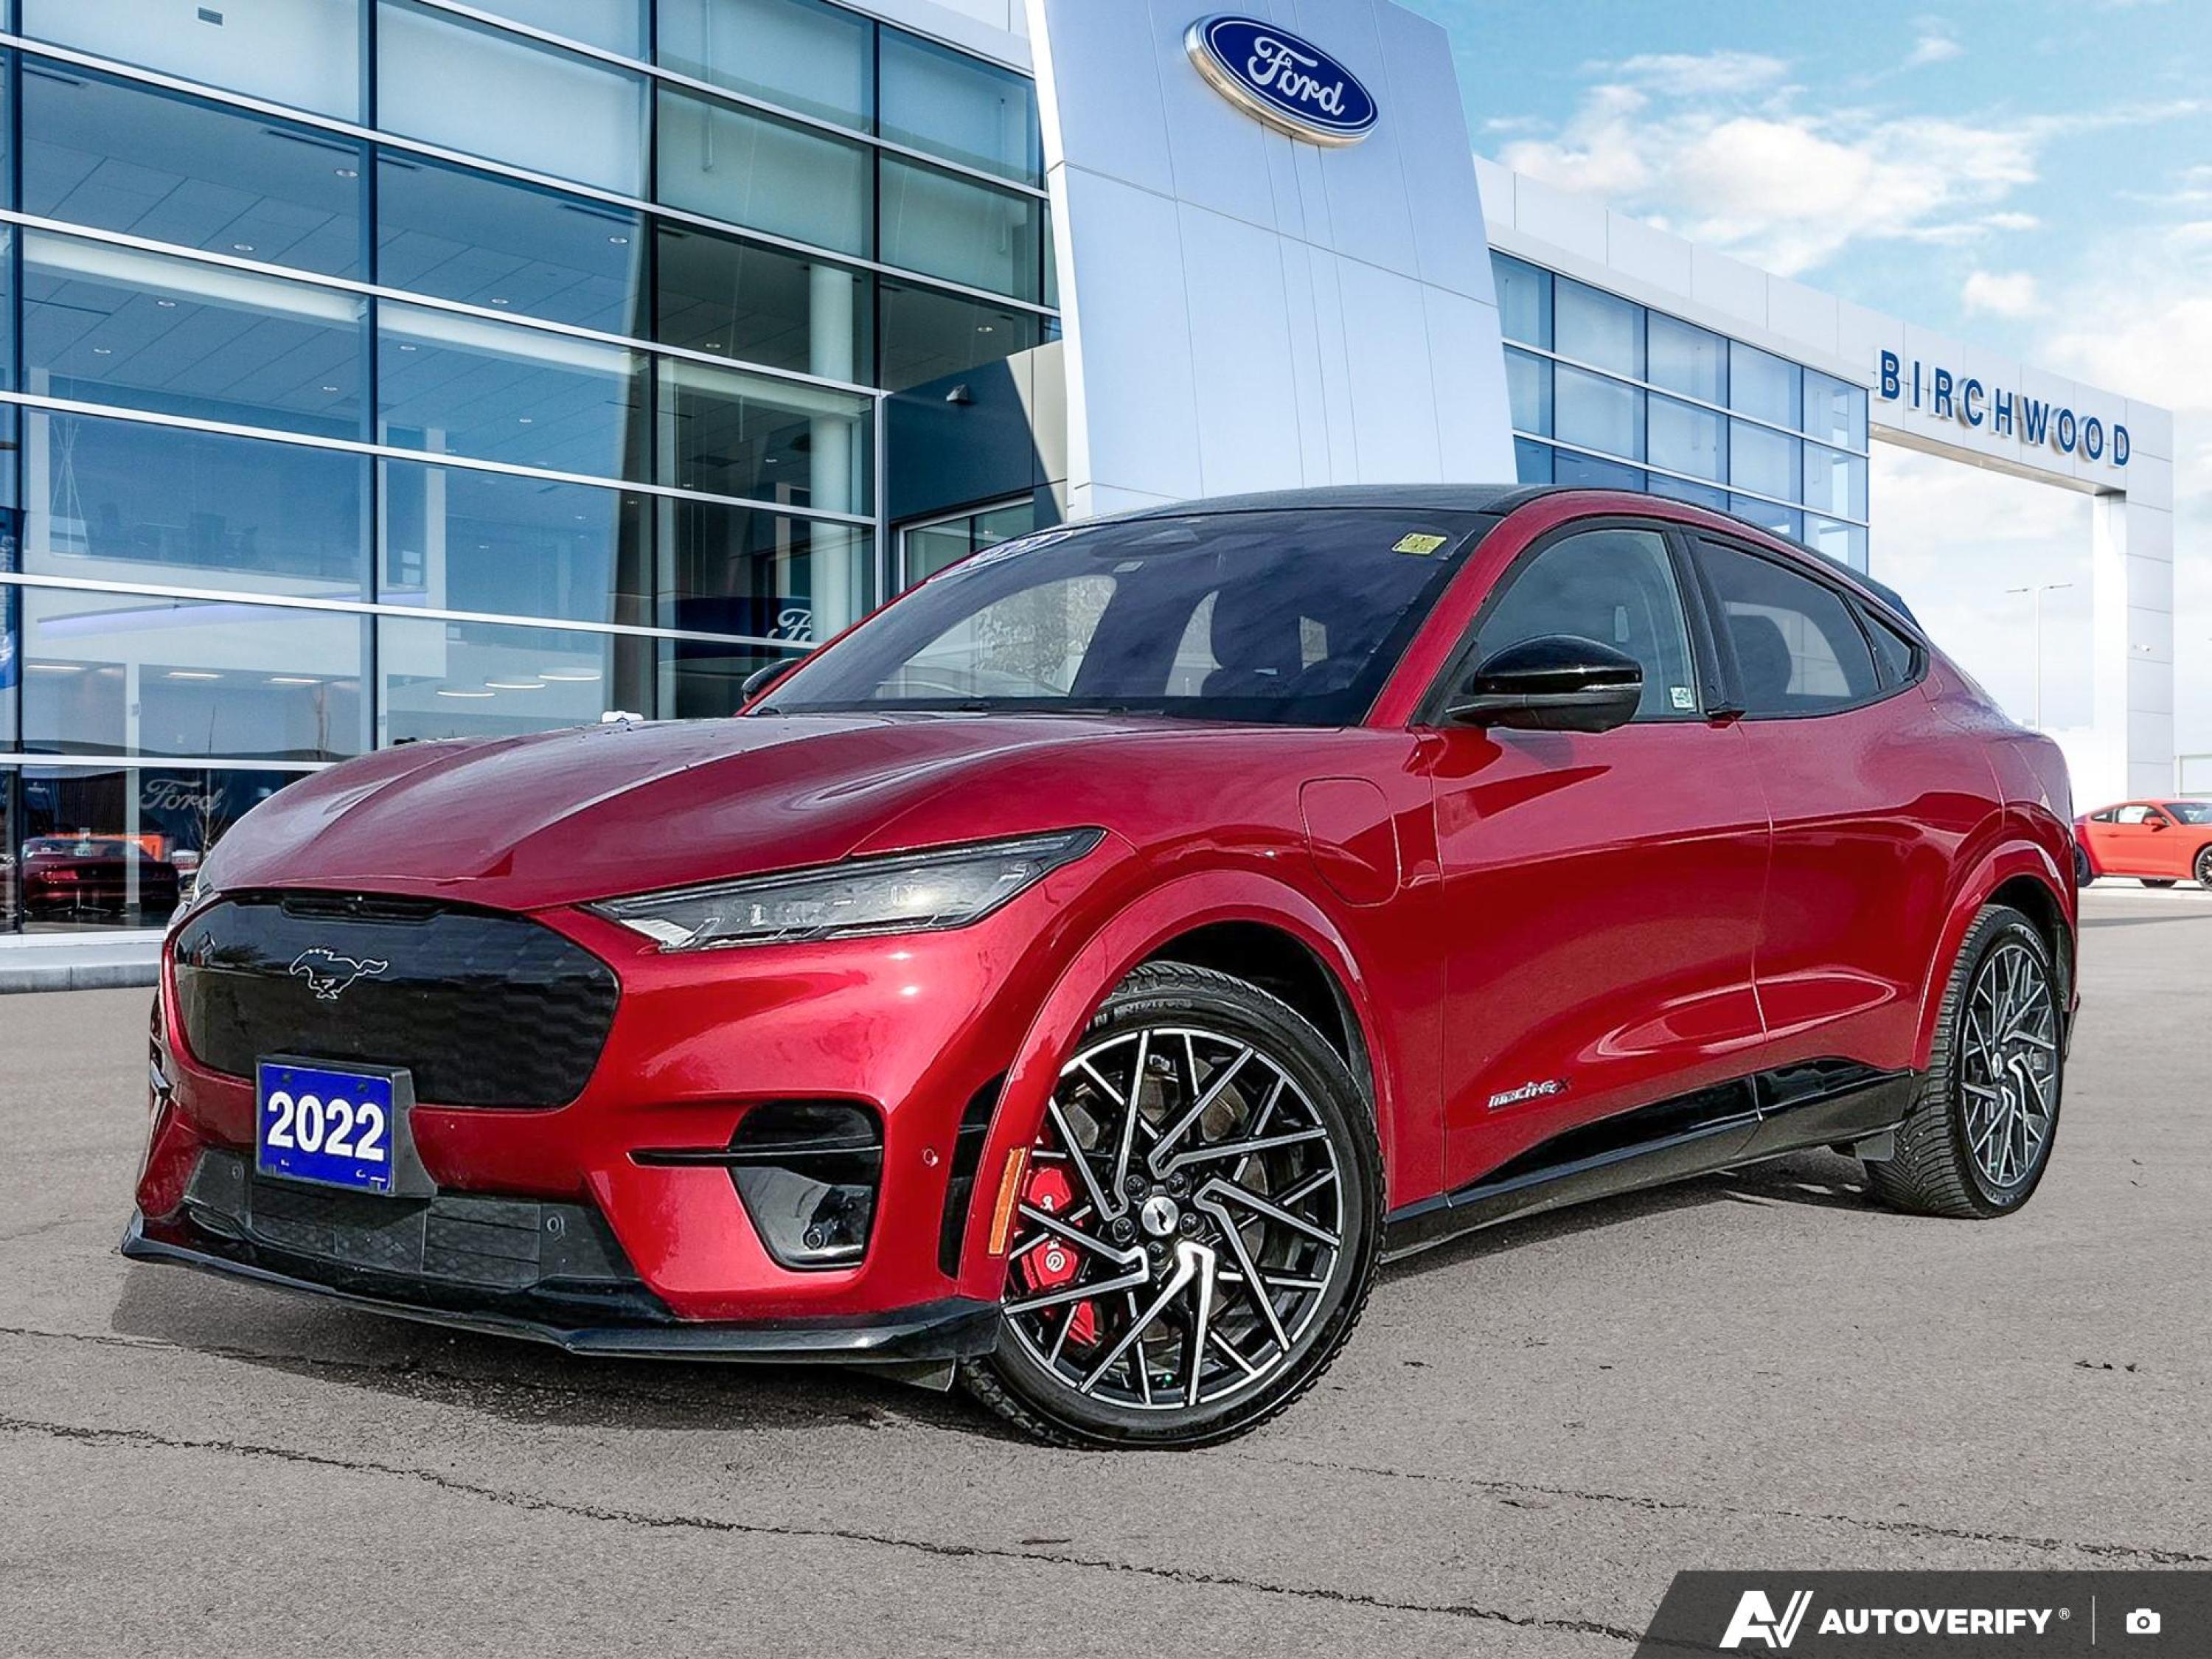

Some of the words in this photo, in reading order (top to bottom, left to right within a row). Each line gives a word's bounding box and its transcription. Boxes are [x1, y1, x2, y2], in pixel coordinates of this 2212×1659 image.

[1248, 36, 1346, 116] Ford
[1881, 349, 2131, 467] BIRCHWOOD
[139, 778, 223, 810] Ford
[267, 1091, 385, 1162] 2022
